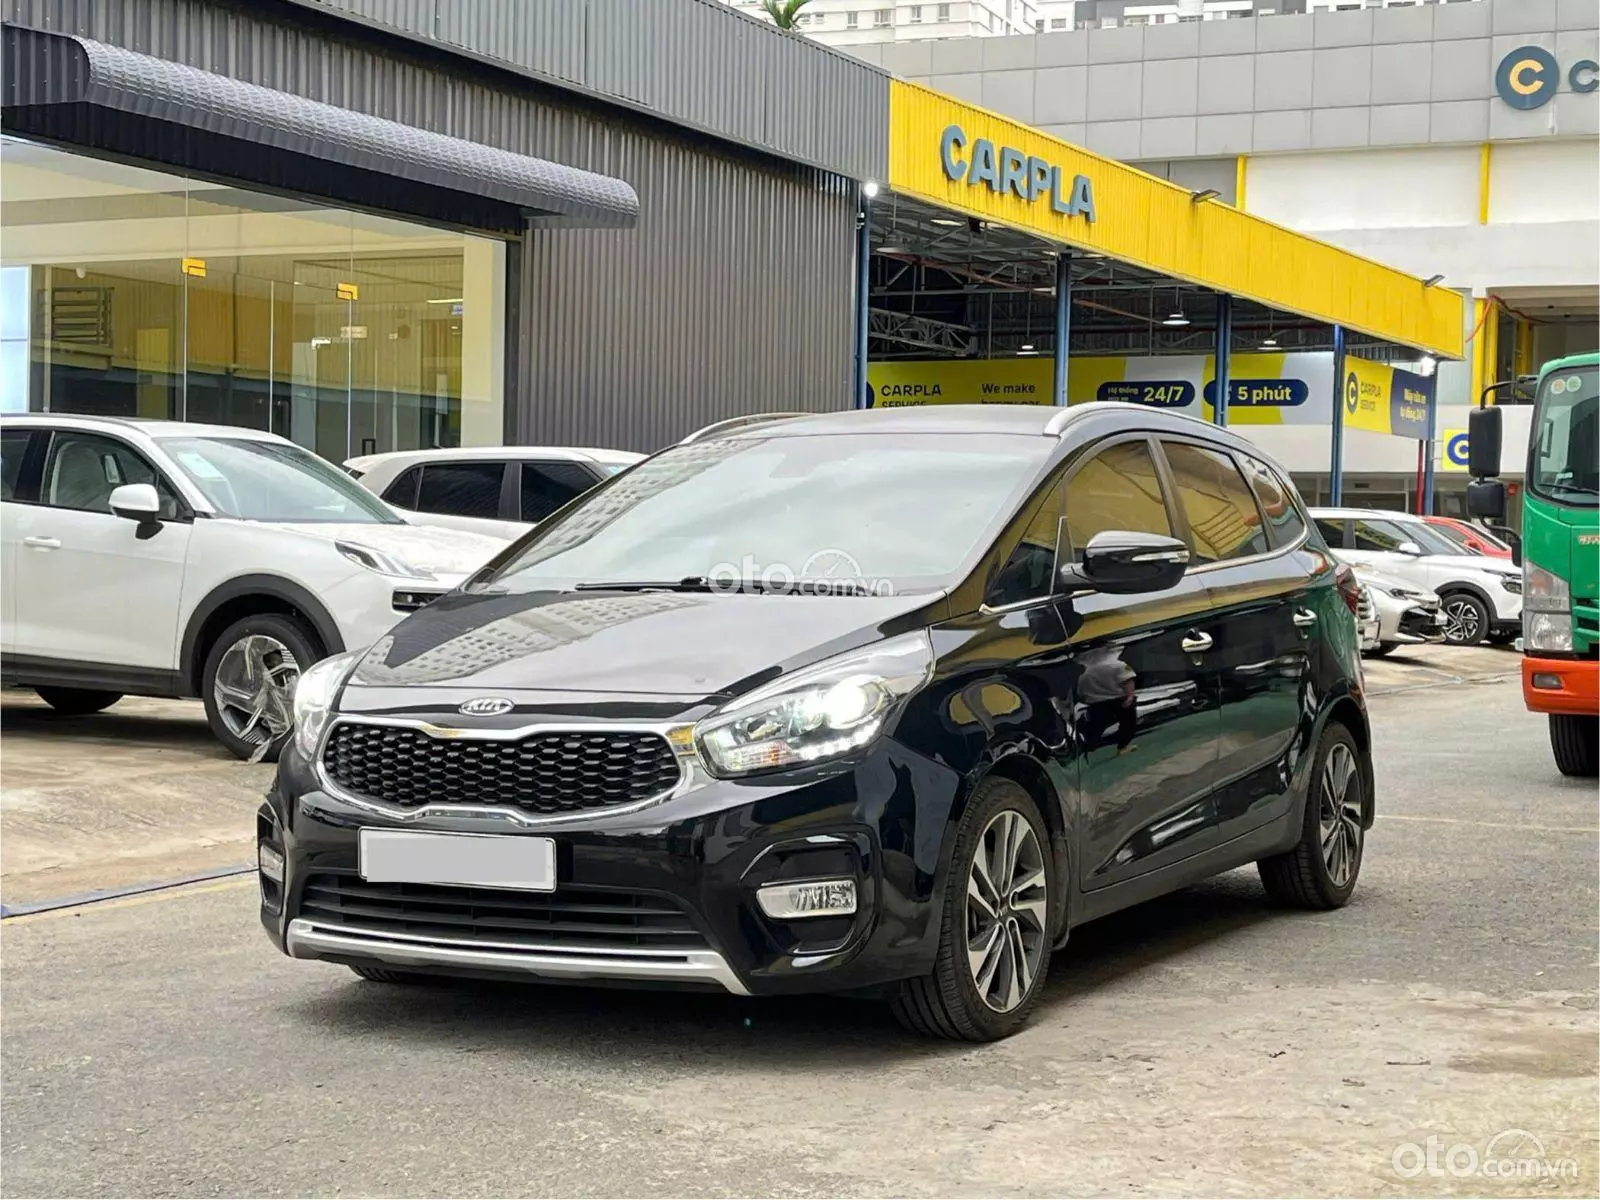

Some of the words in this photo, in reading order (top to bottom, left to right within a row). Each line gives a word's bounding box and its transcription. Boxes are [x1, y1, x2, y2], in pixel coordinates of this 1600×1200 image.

[1509, 59, 1544, 95] C
[940, 124, 1096, 223] CARPLA
[881, 384, 941, 396] CARPLA
[982, 384, 1000, 394] We
[1003, 384, 1036, 394] make
[1143, 386, 1184, 403] 24/7
[1237, 386, 1248, 401] 5
[1252, 385, 1292, 404] phút
